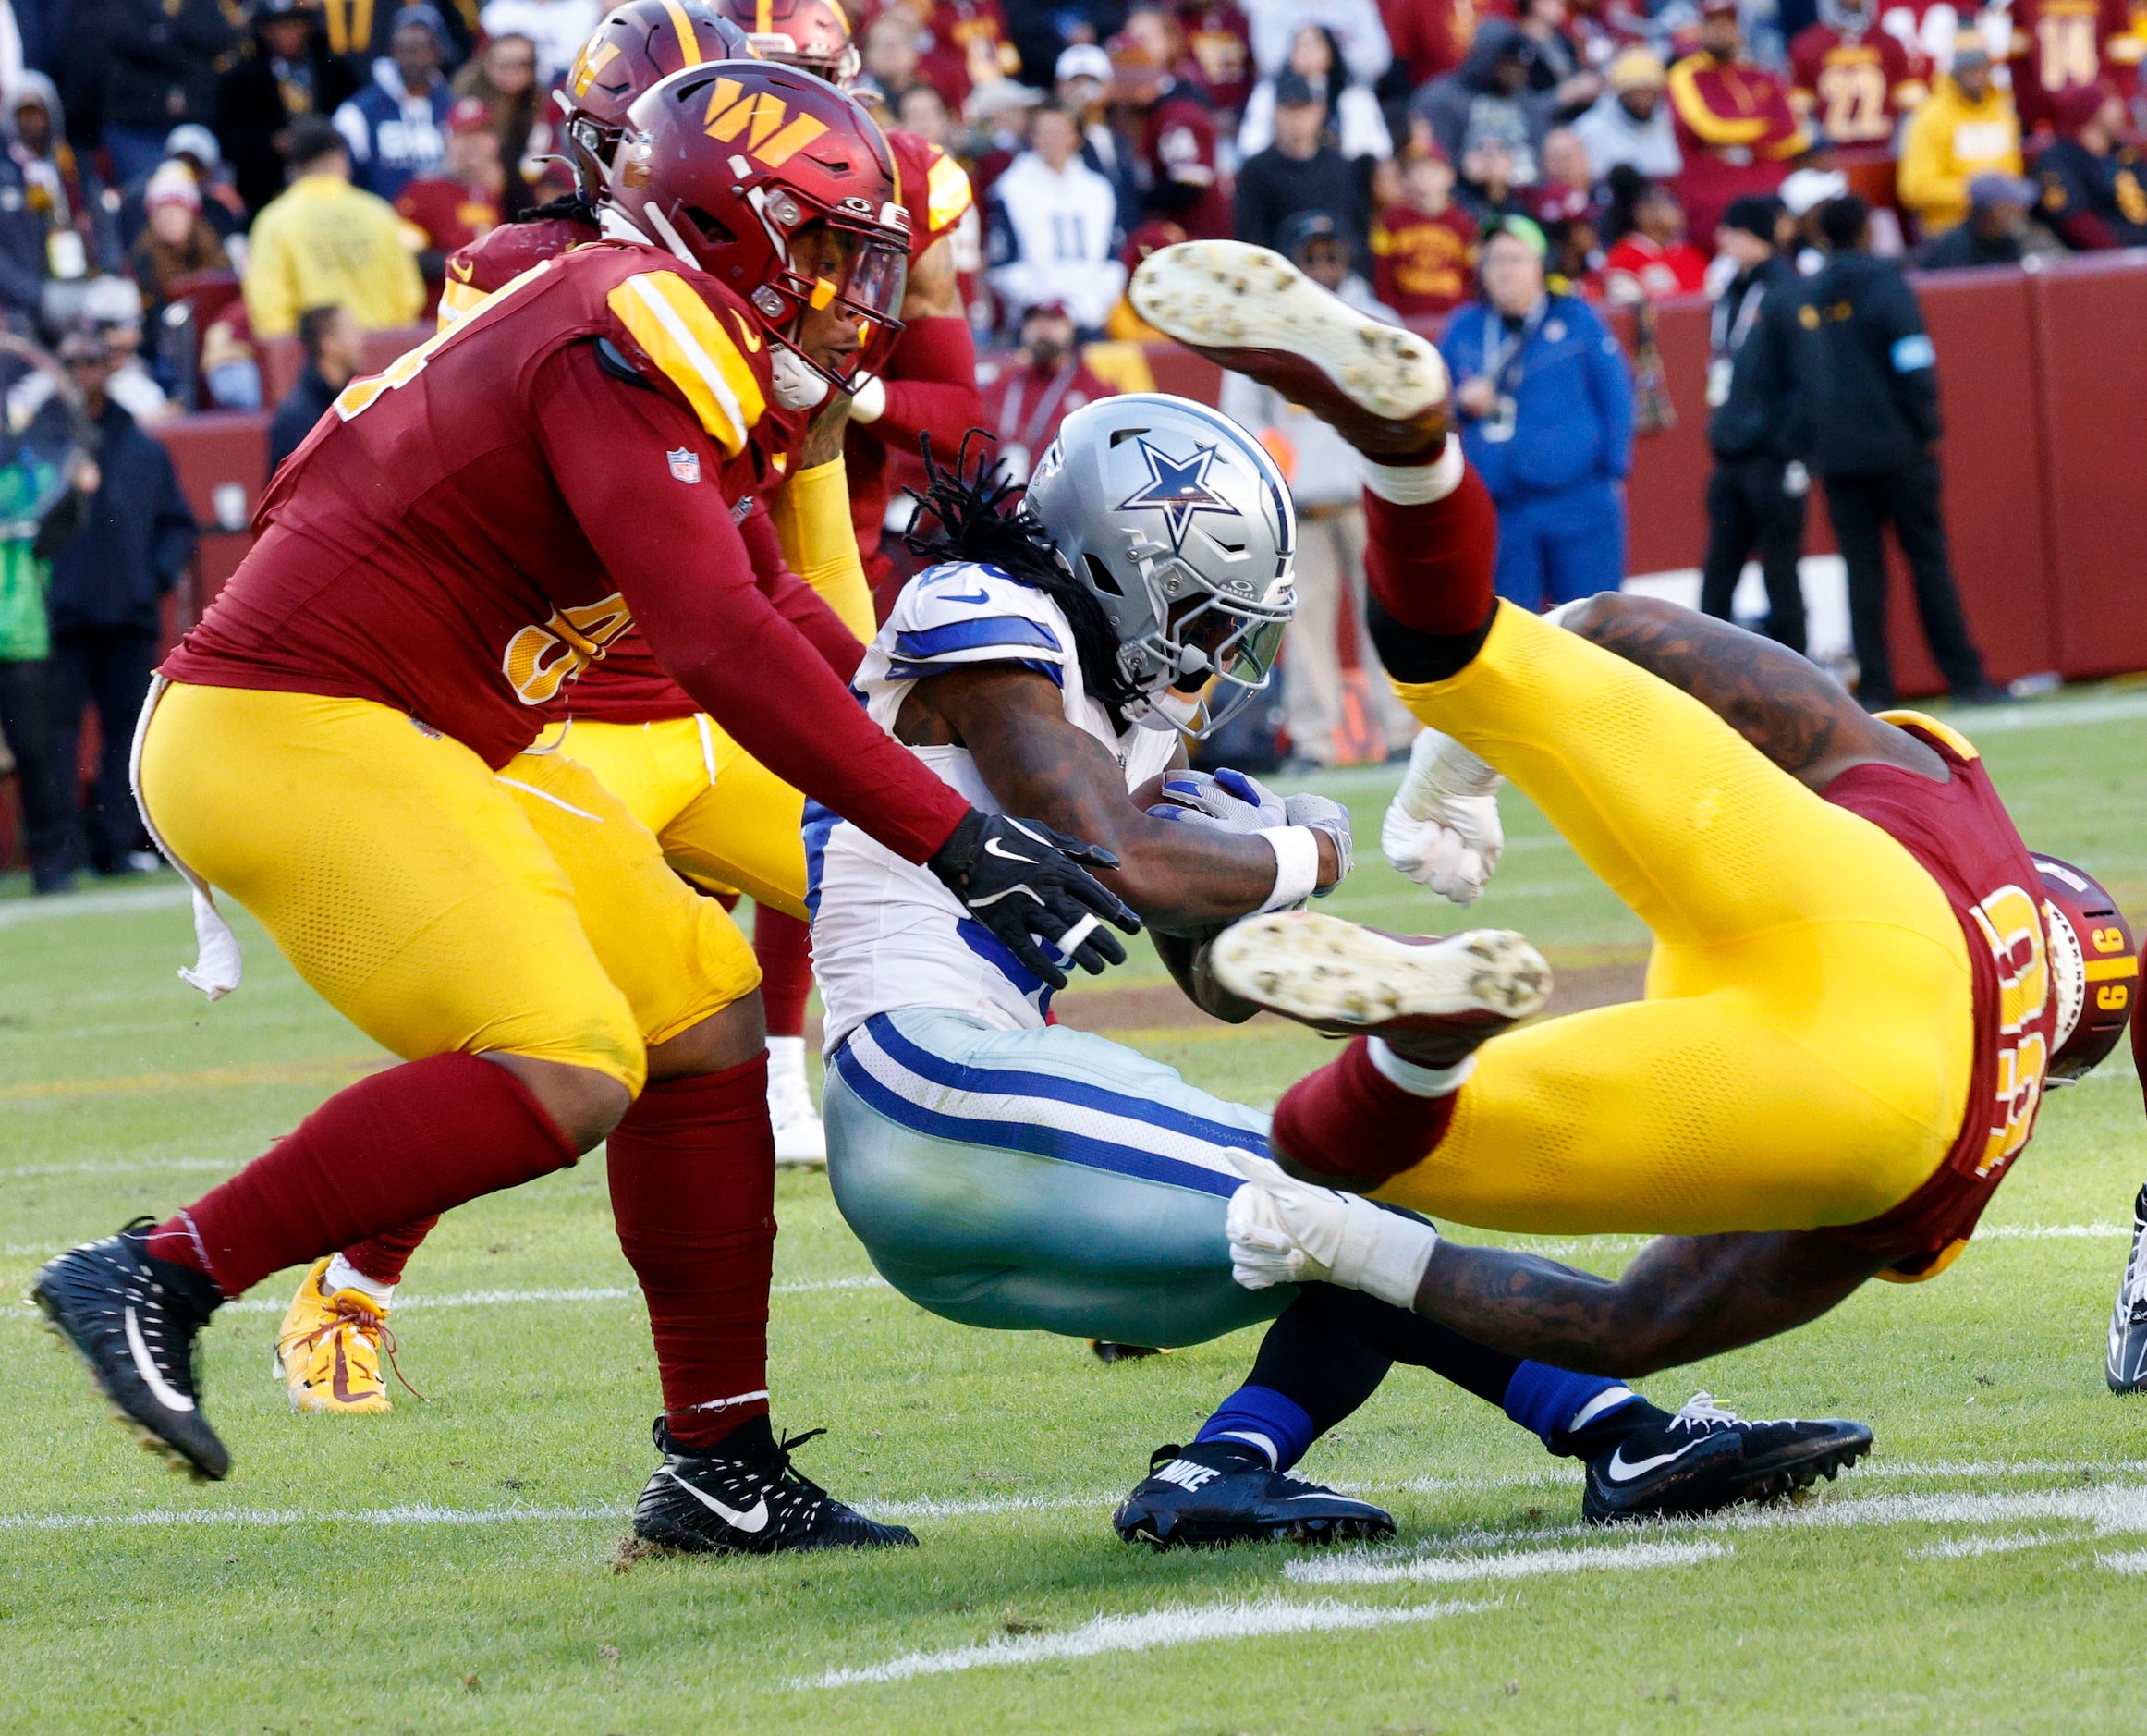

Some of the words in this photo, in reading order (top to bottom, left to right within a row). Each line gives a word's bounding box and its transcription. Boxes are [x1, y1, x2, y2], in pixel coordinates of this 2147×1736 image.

[703, 77, 830, 168] W
[1219, 582, 1256, 600] OAKLEY
[2053, 910, 2081, 1033] WASHINGTON
[1152, 1459, 1221, 1493] NIKE
